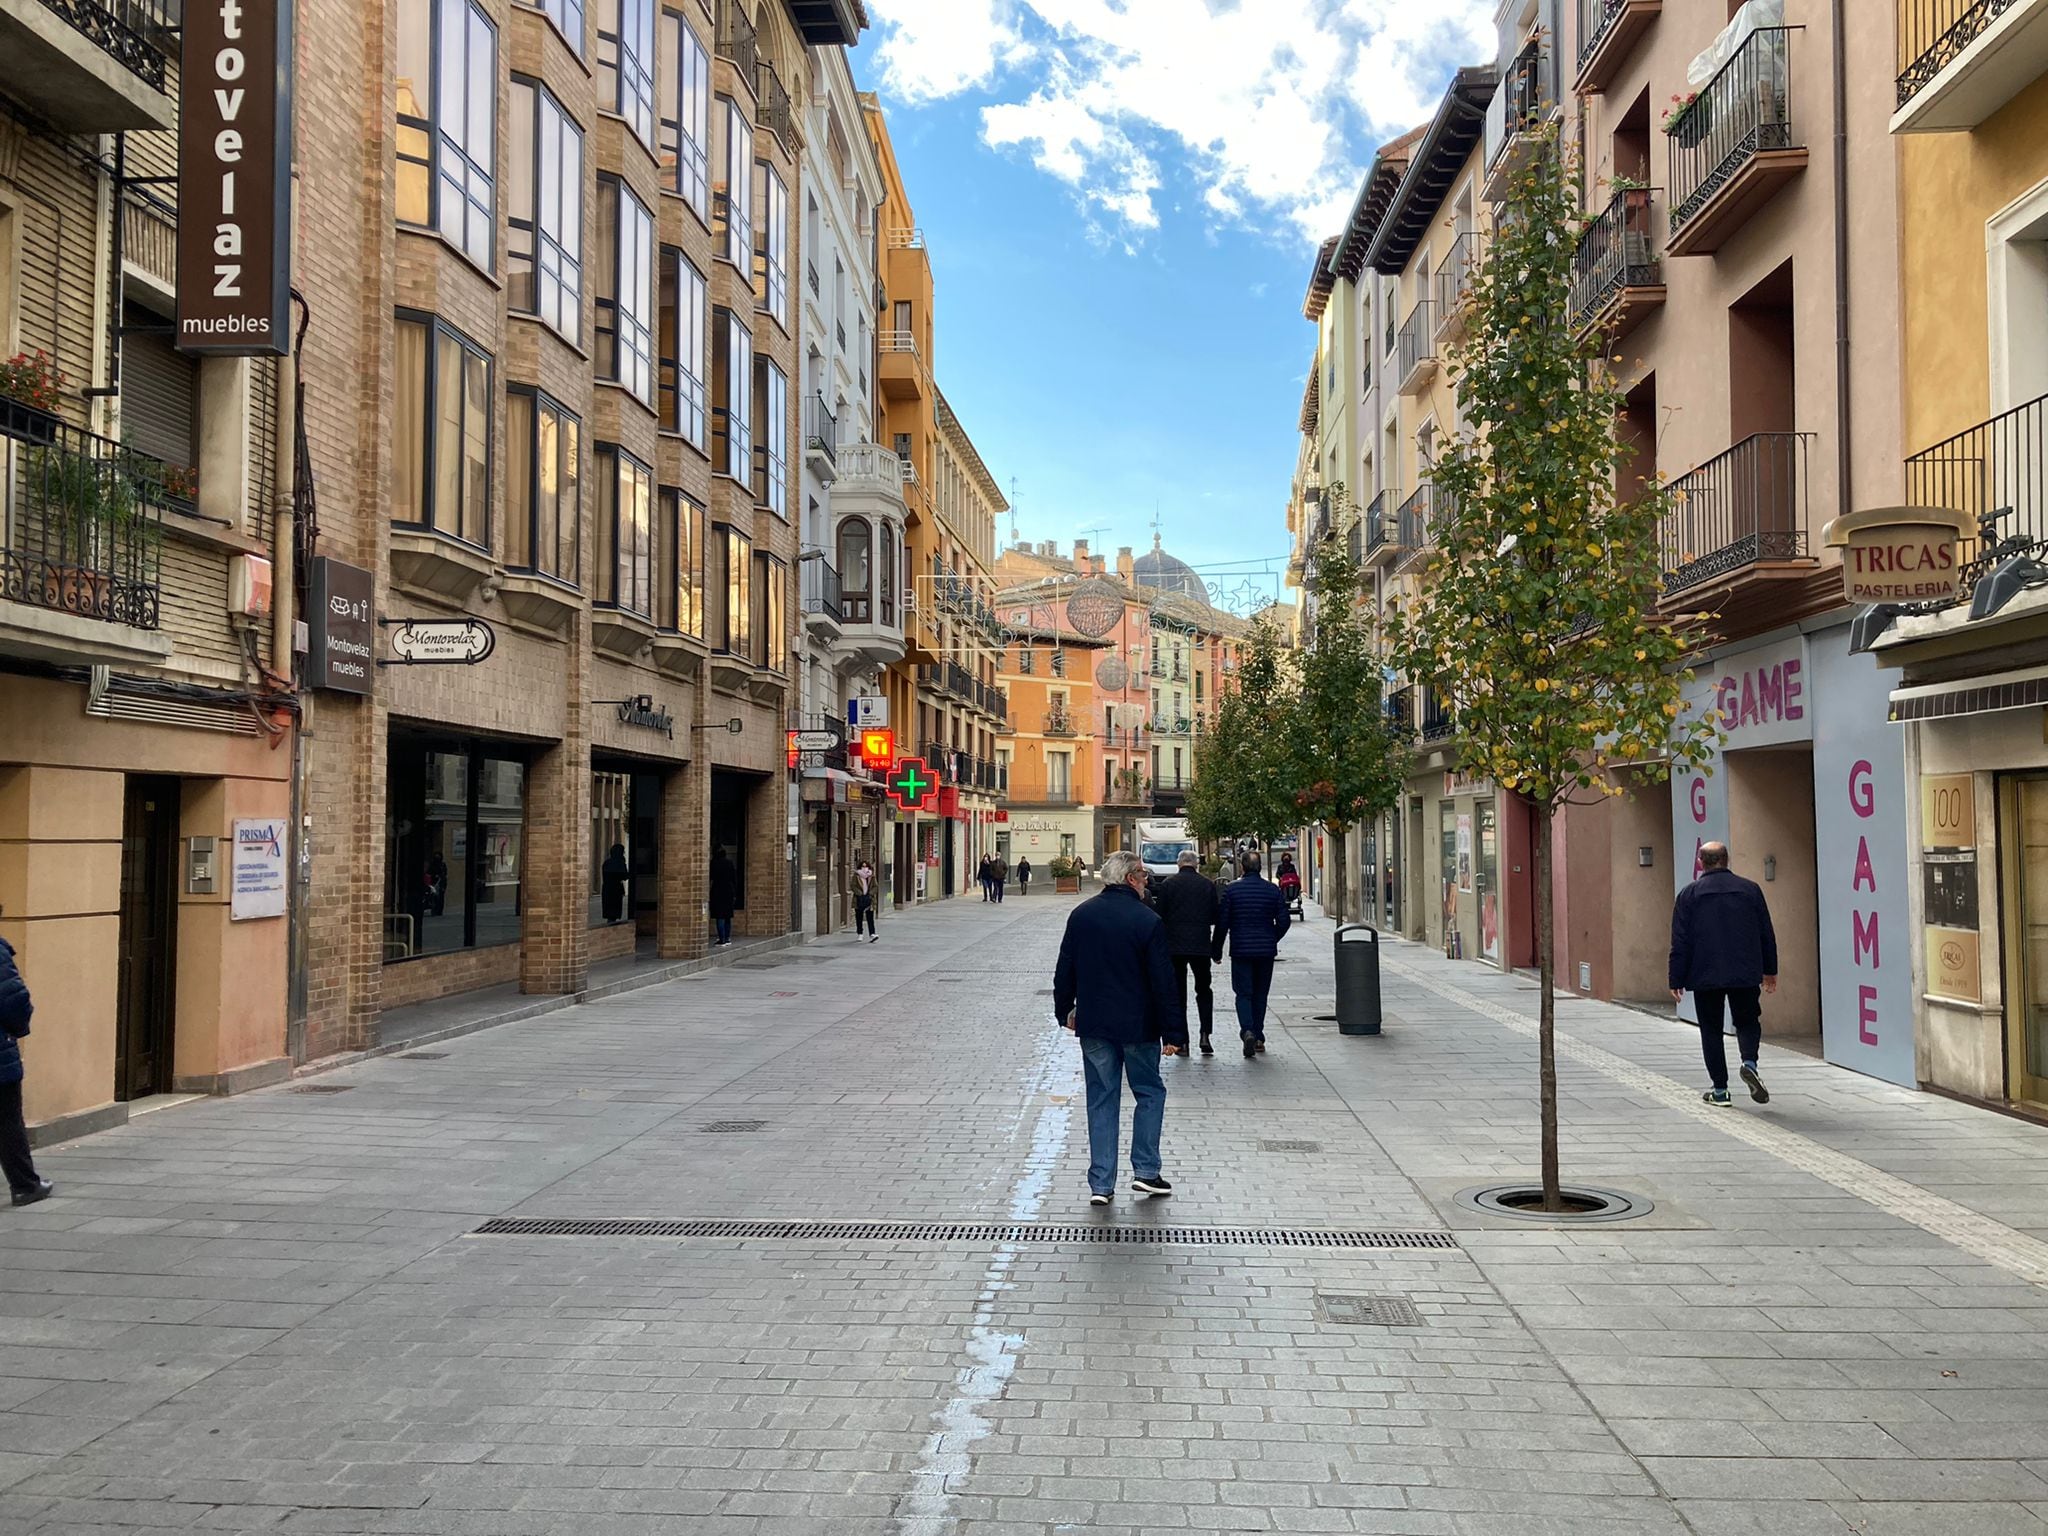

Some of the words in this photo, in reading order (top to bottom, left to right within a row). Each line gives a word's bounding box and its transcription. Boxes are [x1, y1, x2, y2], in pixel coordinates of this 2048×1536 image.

[182, 314, 270, 333] muebles
[1850, 543, 1953, 573] TRICAS
[1853, 580, 1953, 598] PASTELERIA
[327, 635, 370, 659] Montovelaz
[402, 630, 478, 649] Montovelaz
[332, 660, 365, 678] muebles
[1717, 659, 1804, 731] GAME
[1933, 788, 1961, 828] 100
[240, 825, 275, 841] PRISMA
[1848, 760, 1880, 1047] GAME
